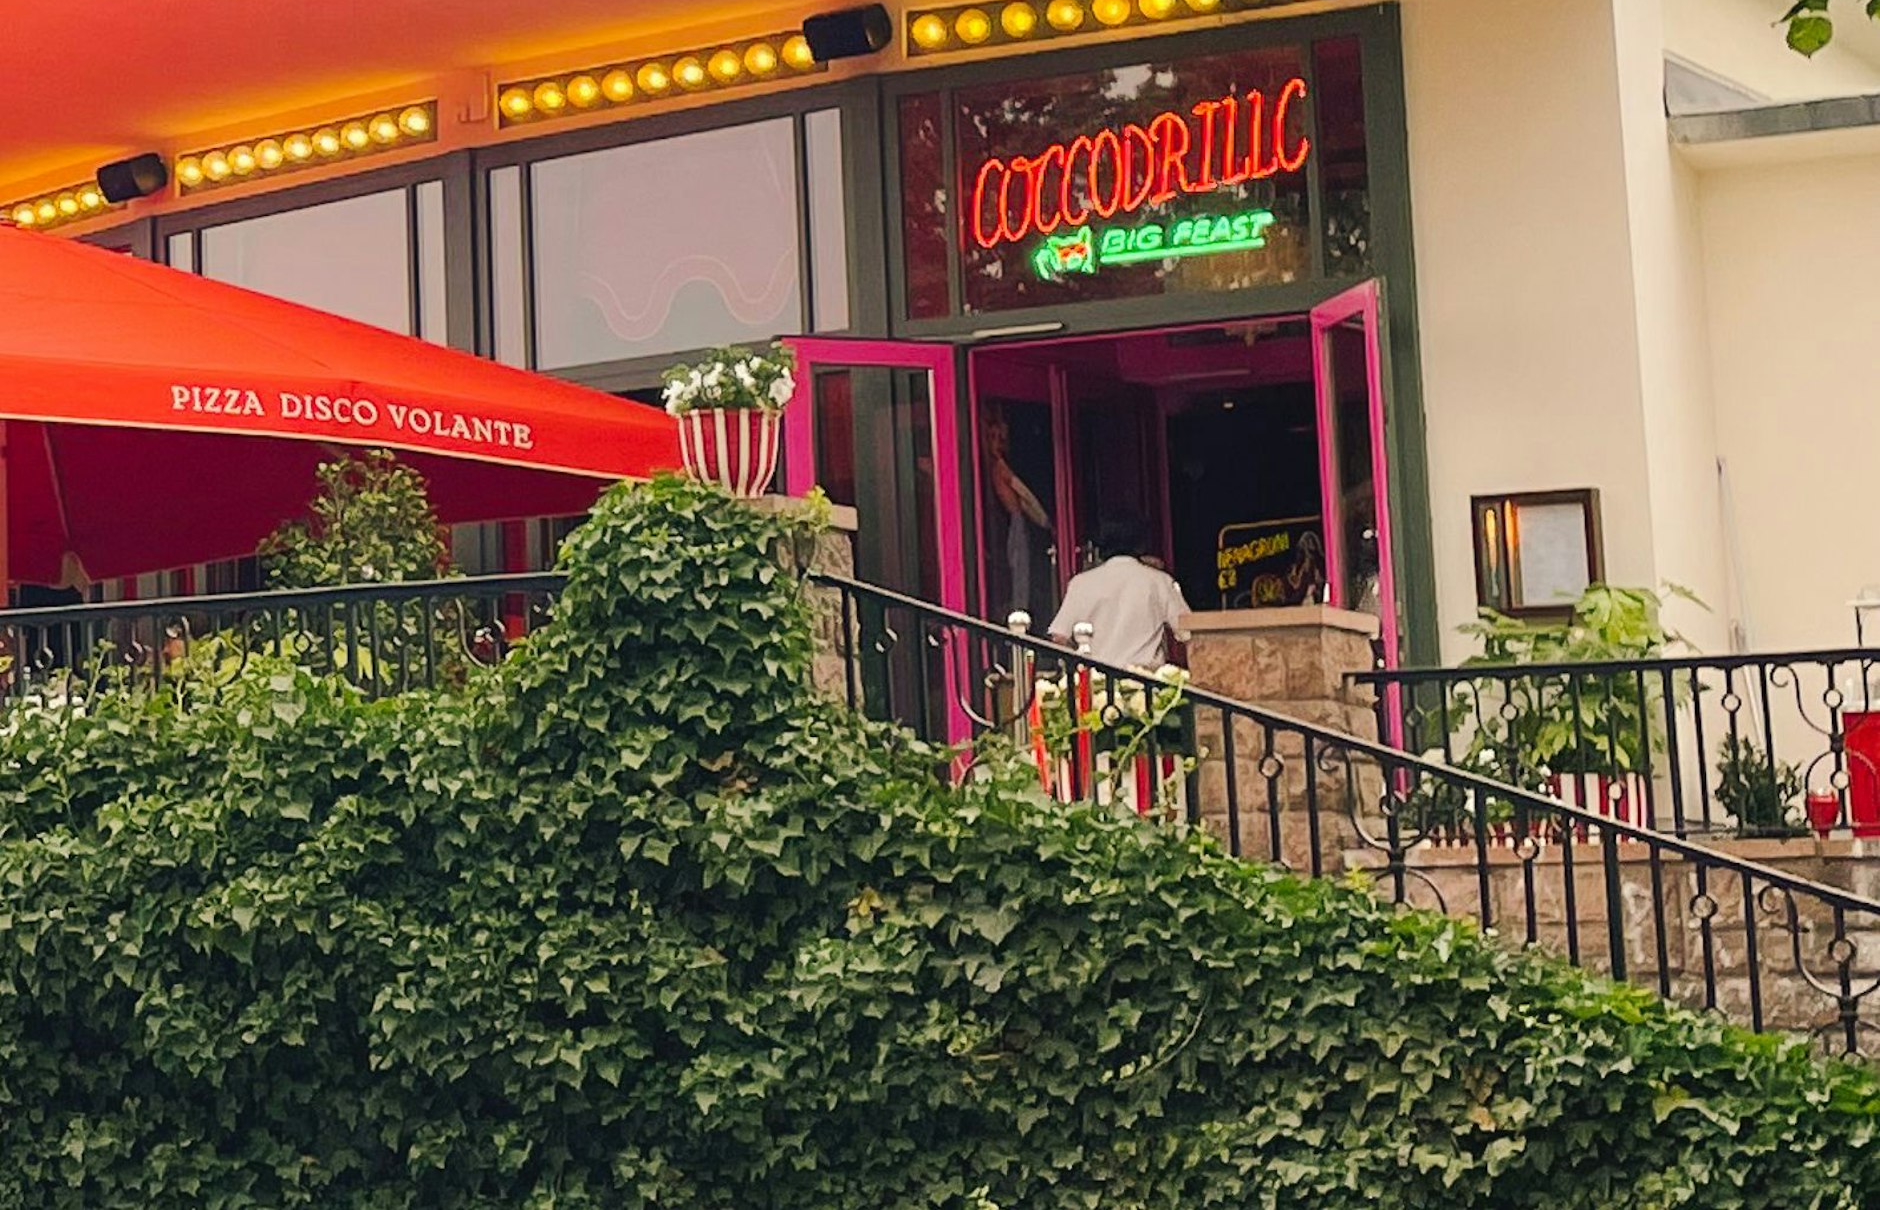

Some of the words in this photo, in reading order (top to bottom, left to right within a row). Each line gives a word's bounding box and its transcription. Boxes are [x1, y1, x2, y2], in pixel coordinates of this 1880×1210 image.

[1101, 224, 1165, 254] BIG
[1173, 209, 1276, 246] FEAST
[171, 385, 265, 417] PIZZA
[279, 391, 379, 426] DISCO
[388, 403, 534, 450] VOLANTE
